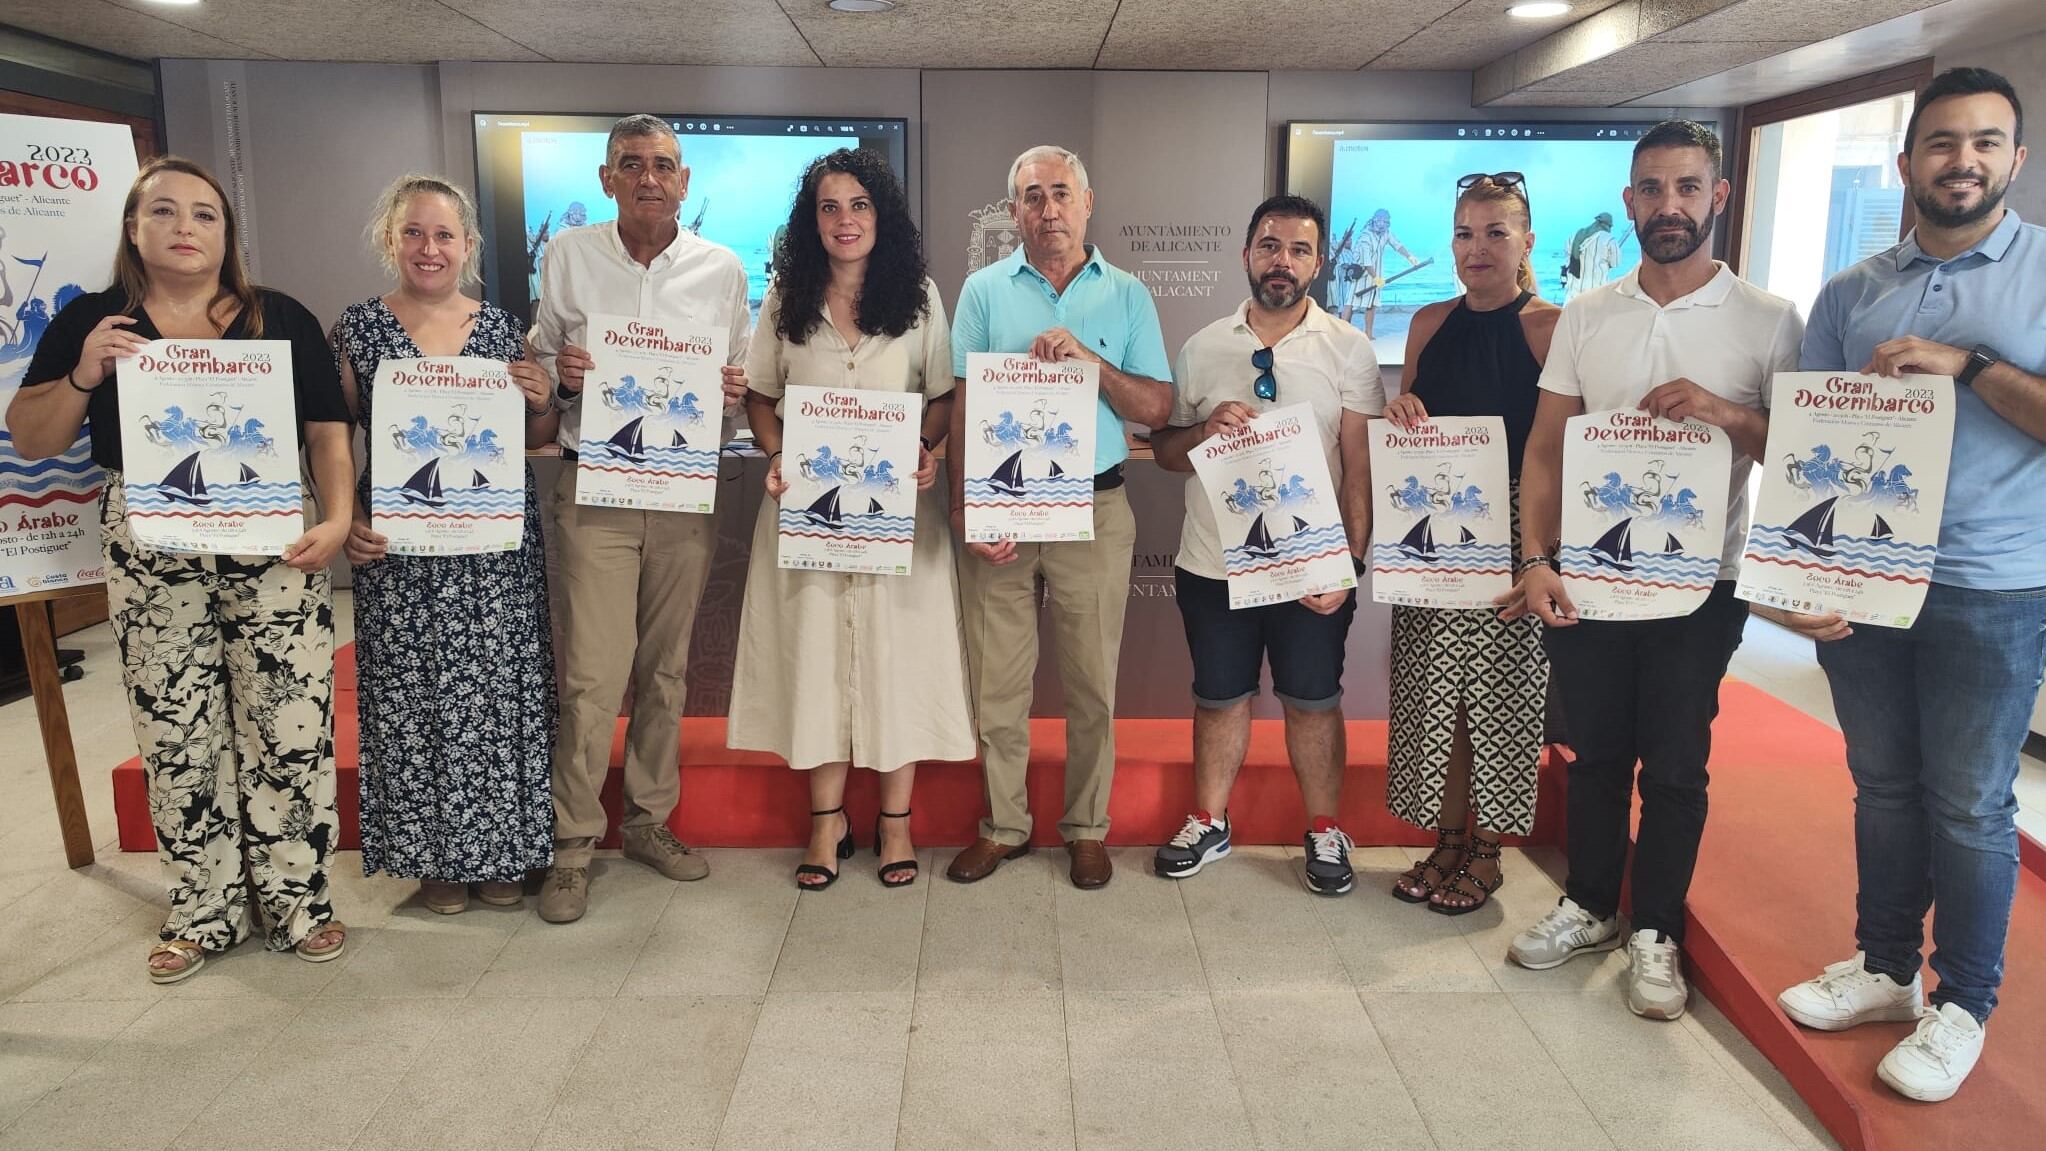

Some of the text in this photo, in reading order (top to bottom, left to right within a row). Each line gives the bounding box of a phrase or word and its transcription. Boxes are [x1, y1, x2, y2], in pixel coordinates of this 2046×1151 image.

[27, 144, 92, 166] 2023
[32, 195, 71, 205] Alicante
[8, 206, 21, 215] de
[24, 207, 65, 217] Alicante
[1131, 241, 1222, 252] DE ALICANTE
[627, 321, 664, 337] Gran
[604, 330, 712, 355] Desembarco
[165, 344, 211, 360] Gran
[242, 352, 271, 363] 2023
[139, 355, 272, 374] Desembarco
[417, 360, 454, 374] Gran
[1003, 357, 1038, 371] Gran
[392, 371, 508, 389] Desembarco
[982, 367, 1084, 384] Desembarco
[1826, 377, 1873, 395] Gran
[1904, 388, 1935, 400] 2023
[823, 391, 858, 406] Gran
[1794, 389, 1935, 414] Desembarco
[801, 401, 905, 423] Desembarco
[1464, 426, 1489, 435] 2023
[1584, 425, 1712, 444] Desembarco
[1682, 422, 1710, 433] 2023
[1205, 424, 1301, 459] Desembarco
[1386, 432, 1490, 449] Desembarco
[16, 510, 79, 531] Árabe
[26, 532, 39, 542] de
[67, 528, 85, 539] 24h
